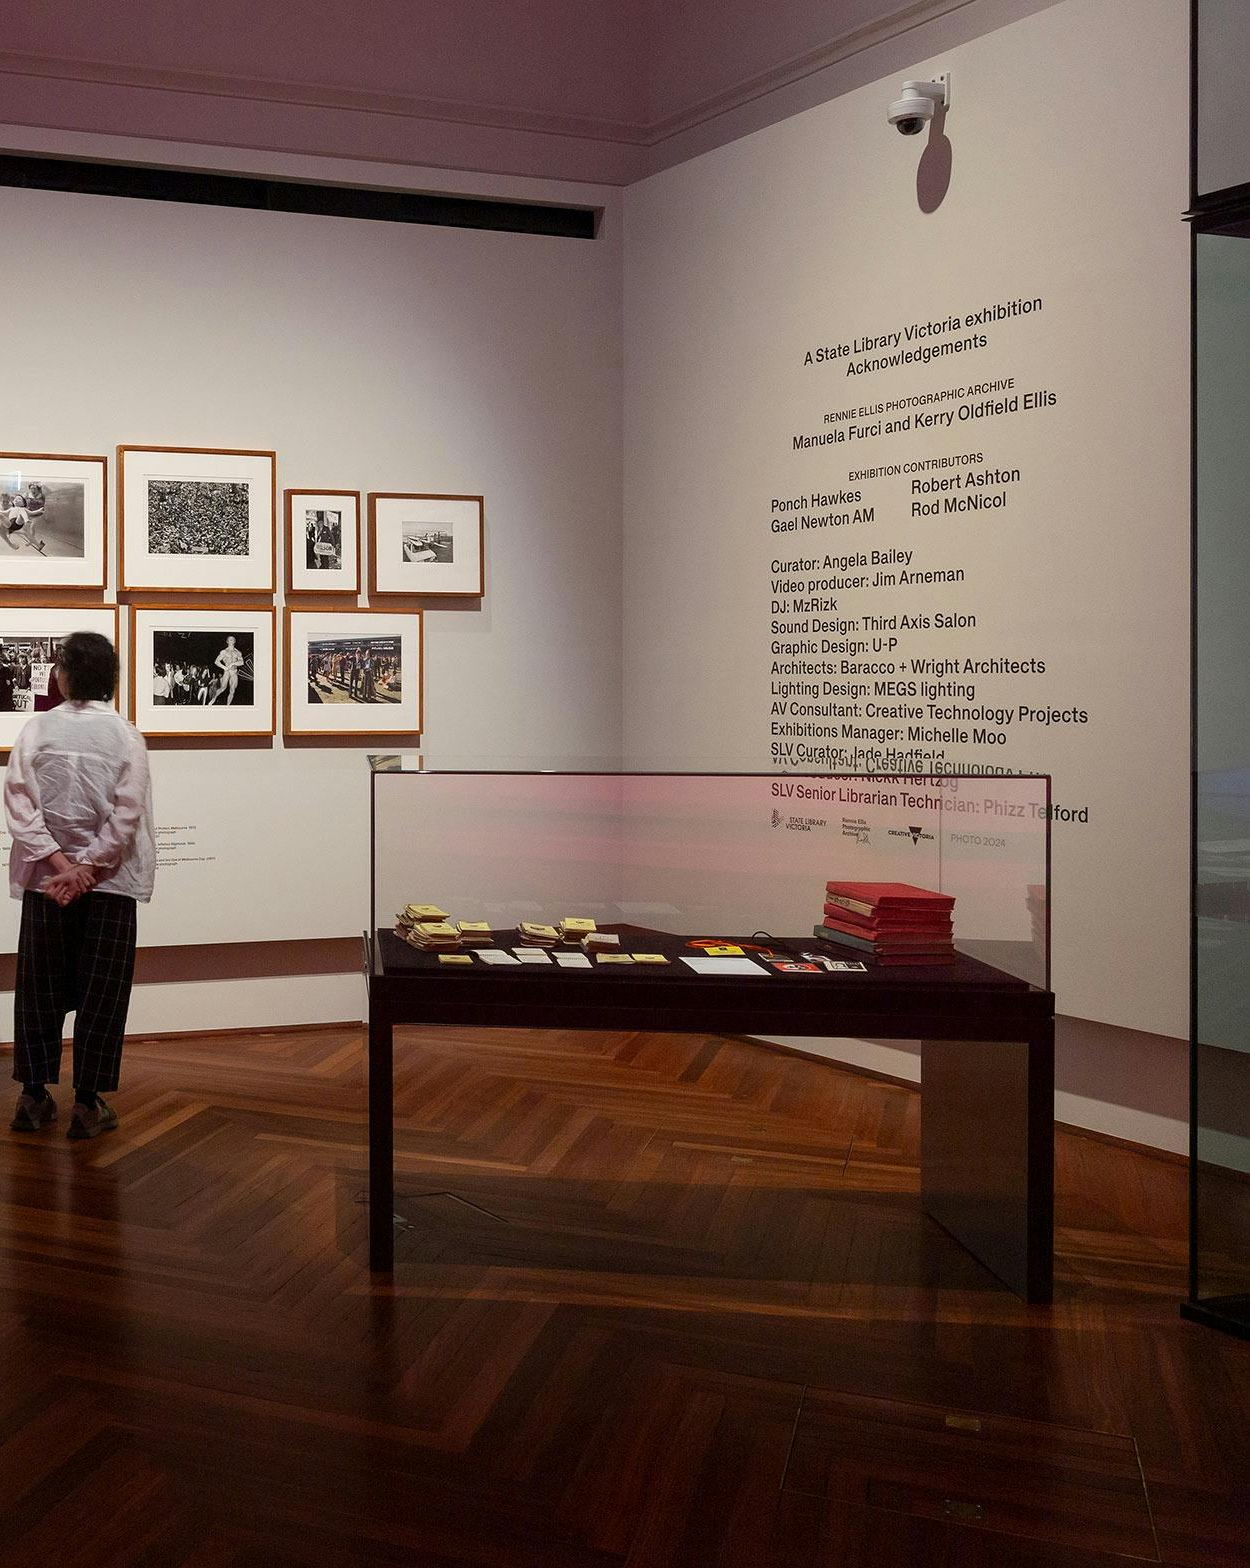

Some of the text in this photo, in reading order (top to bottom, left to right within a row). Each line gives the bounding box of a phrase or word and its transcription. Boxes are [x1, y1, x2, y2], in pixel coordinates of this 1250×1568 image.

[804, 298, 1042, 366] A State Library Victoria exhibition
[846, 334, 987, 377] Acknowledgements
[824, 378, 1014, 424] RENNIE ELLIS PHOTOGRAPHIC ARCHIVE
[793, 390, 1056, 450] Manuela Furci and Kerry Oldfield Ellis
[849, 452, 983, 481] EXHIBITION CONTRIBUTORS
[912, 469, 1020, 494] Robert Ashton
[771, 490, 861, 513] Ponch Hawkes
[912, 491, 1006, 517] Rod McNicol
[771, 507, 874, 533] Gael Newton AM
[771, 549, 913, 573] Curator: Angela Bailey
[771, 569, 964, 595] Video producer: Jim Arneman
[772, 597, 837, 614] DJ: MzRizk
[771, 613, 976, 636] Sound Design: Third Axis Salon
[771, 637, 897, 657] Graphic Design: U-P
[771, 658, 1045, 678] Architects: Baracco + Wright Architects
[771, 681, 975, 701] Lighting Design: MEGS lighting
[771, 702, 1088, 726] AV Consultant: Creative Technology Projects
[771, 722, 1006, 745] Exhibitions Manager: Michelle Moo
[771, 742, 794, 756] SLV
[796, 743, 846, 759] Curator:
[771, 782, 794, 797] SLV
[796, 784, 836, 801] Senior
[839, 788, 897, 806] Librarian
[900, 792, 980, 814] Technician:
[984, 799, 1026, 818] Phizz
[785, 823, 812, 832] VICTORIA
[789, 816, 828, 828] STATE LIBRARY
[888, 829, 912, 838] CREATIVE
[951, 833, 1007, 848] PHOTO 2024
